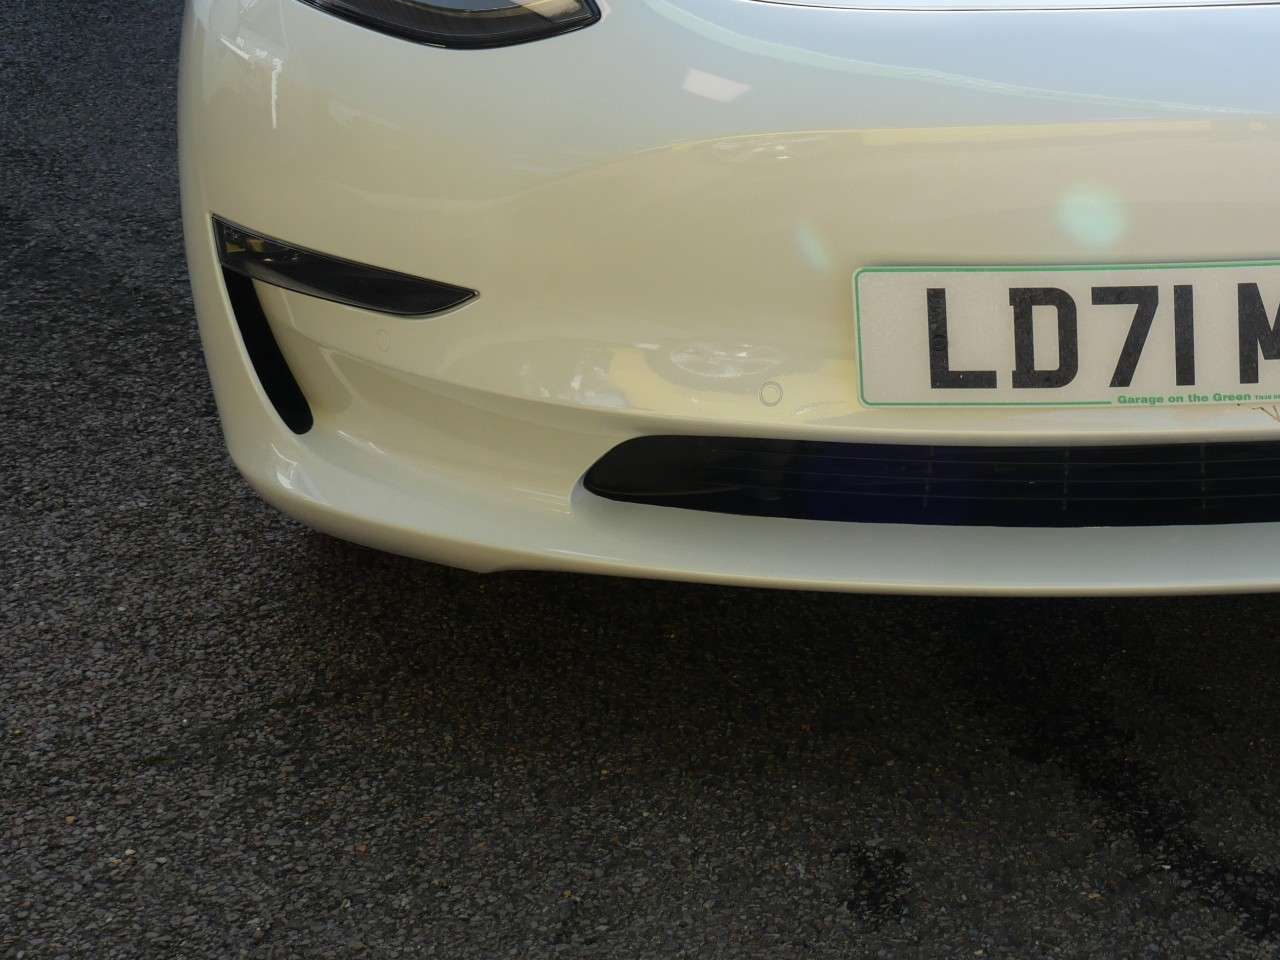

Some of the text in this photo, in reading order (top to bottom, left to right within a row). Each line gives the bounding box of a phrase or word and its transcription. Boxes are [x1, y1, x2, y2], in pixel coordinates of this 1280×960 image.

[927, 285, 1195, 388] LD71
[1117, 394, 1164, 405] Garage
[1168, 395, 1185, 403] on
[1187, 392, 1209, 403] the
[1212, 392, 1252, 402] Green
